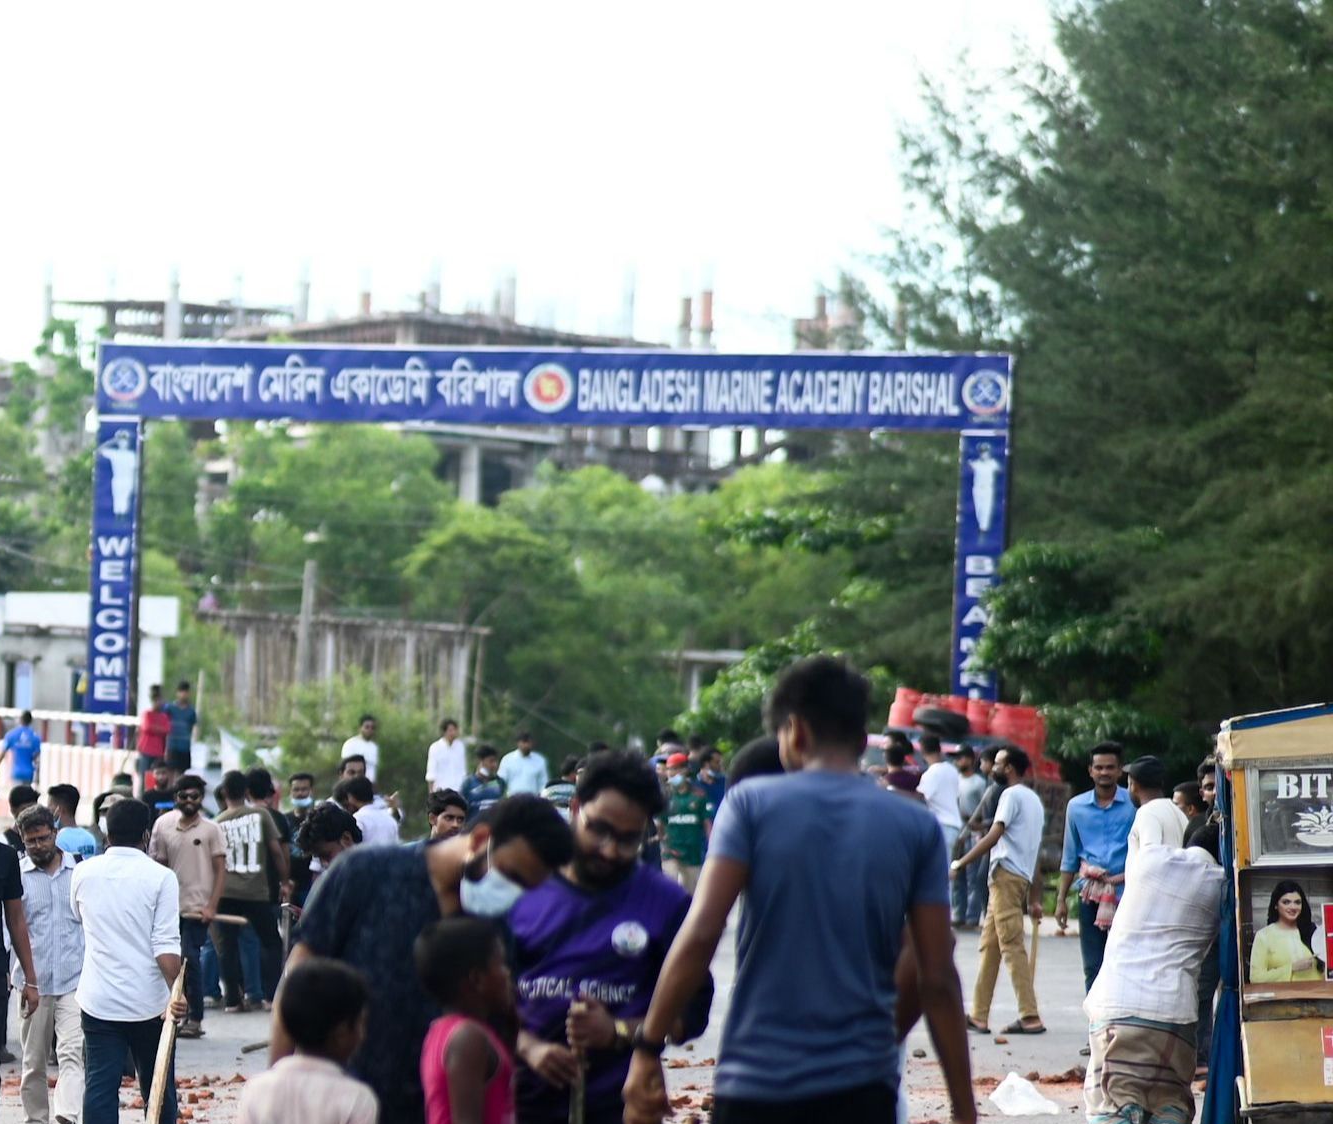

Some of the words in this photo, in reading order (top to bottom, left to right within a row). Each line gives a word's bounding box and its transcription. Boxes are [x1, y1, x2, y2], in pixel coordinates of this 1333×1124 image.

[148, 361, 254, 404] বাংলাদেশ
[258, 353, 327, 404] মেরিন
[330, 355, 433, 407] একাডেমি
[435, 356, 522, 409] বরিশাল
[576, 368, 701, 413] BANGLADESH
[703, 369, 773, 415] MARINE
[775, 370, 868, 416] ACADEMY
[868, 371, 961, 418] BARISHAL
[93, 536, 130, 702] WELCOME
